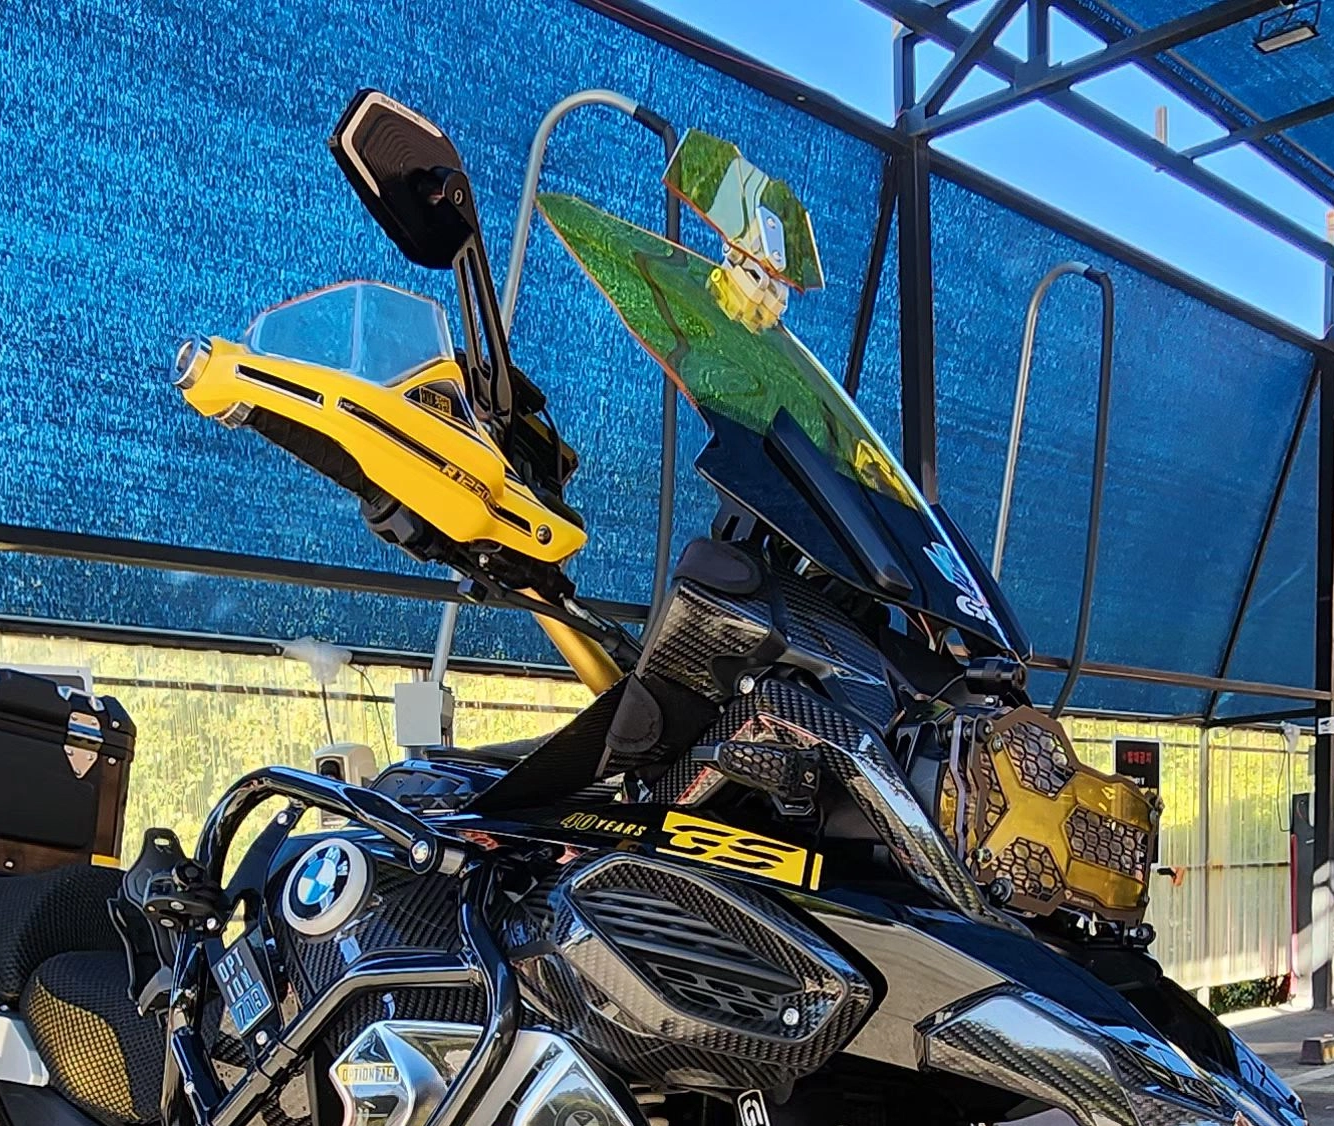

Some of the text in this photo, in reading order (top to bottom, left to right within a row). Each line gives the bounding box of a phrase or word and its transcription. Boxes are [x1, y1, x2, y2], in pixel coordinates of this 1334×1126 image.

[442, 462, 491, 501] R1250
[561, 812, 648, 837] 40 YEARS
[669, 825, 801, 870] GS
[234, 989, 267, 1030] 719
[342, 1068, 375, 1082] OPTION
